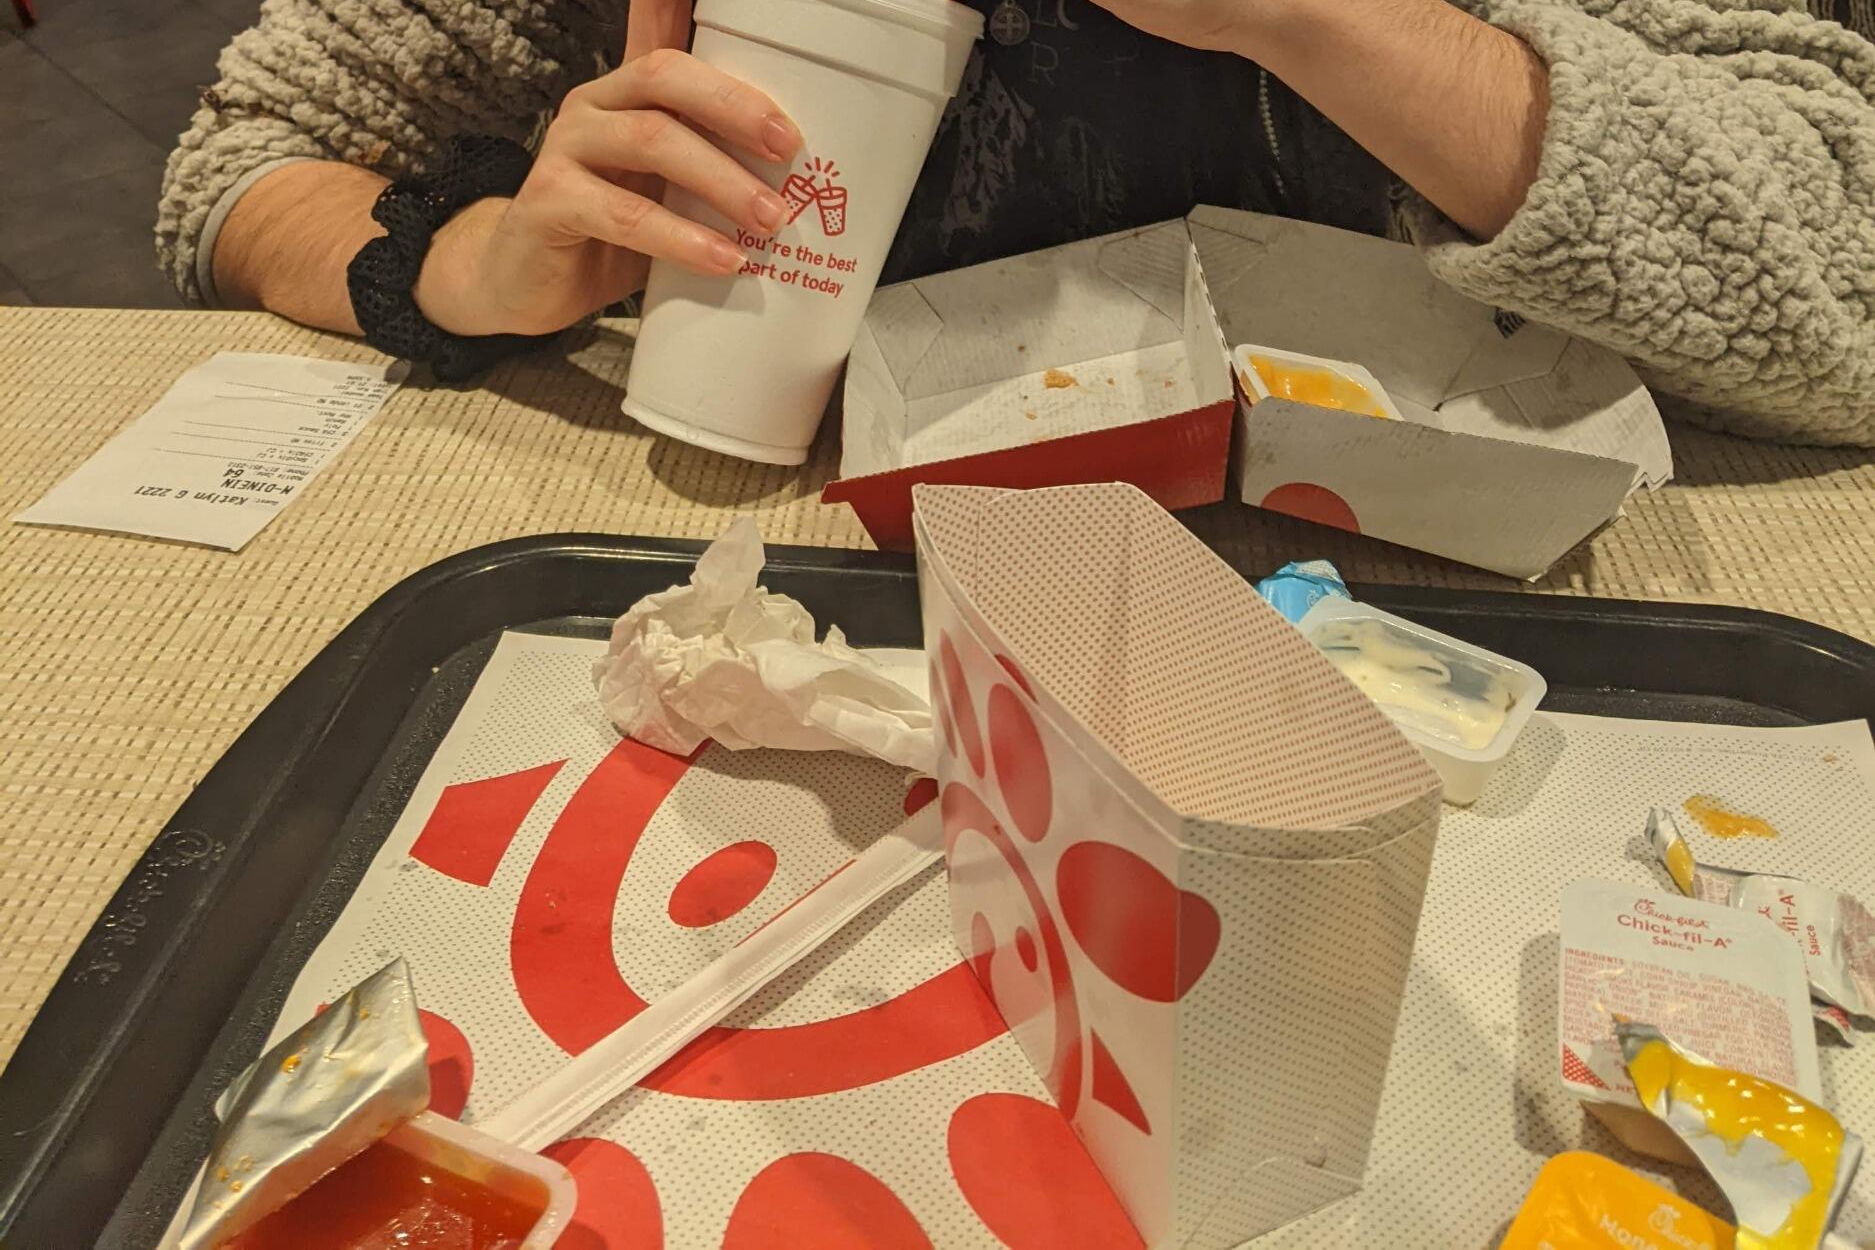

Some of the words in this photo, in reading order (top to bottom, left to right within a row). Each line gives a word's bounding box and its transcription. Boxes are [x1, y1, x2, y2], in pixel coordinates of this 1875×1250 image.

[737, 228, 791, 257] You're
[796, 245, 823, 266] the
[827, 253, 857, 272] best
[738, 260, 777, 280] part
[780, 270, 800, 285] of
[802, 273, 844, 298] today
[223, 468, 245, 478] 64
[194, 491, 248, 506] Katlyn
[1652, 935, 1695, 952] Sauce
[1806, 924, 1822, 956] Sauce
